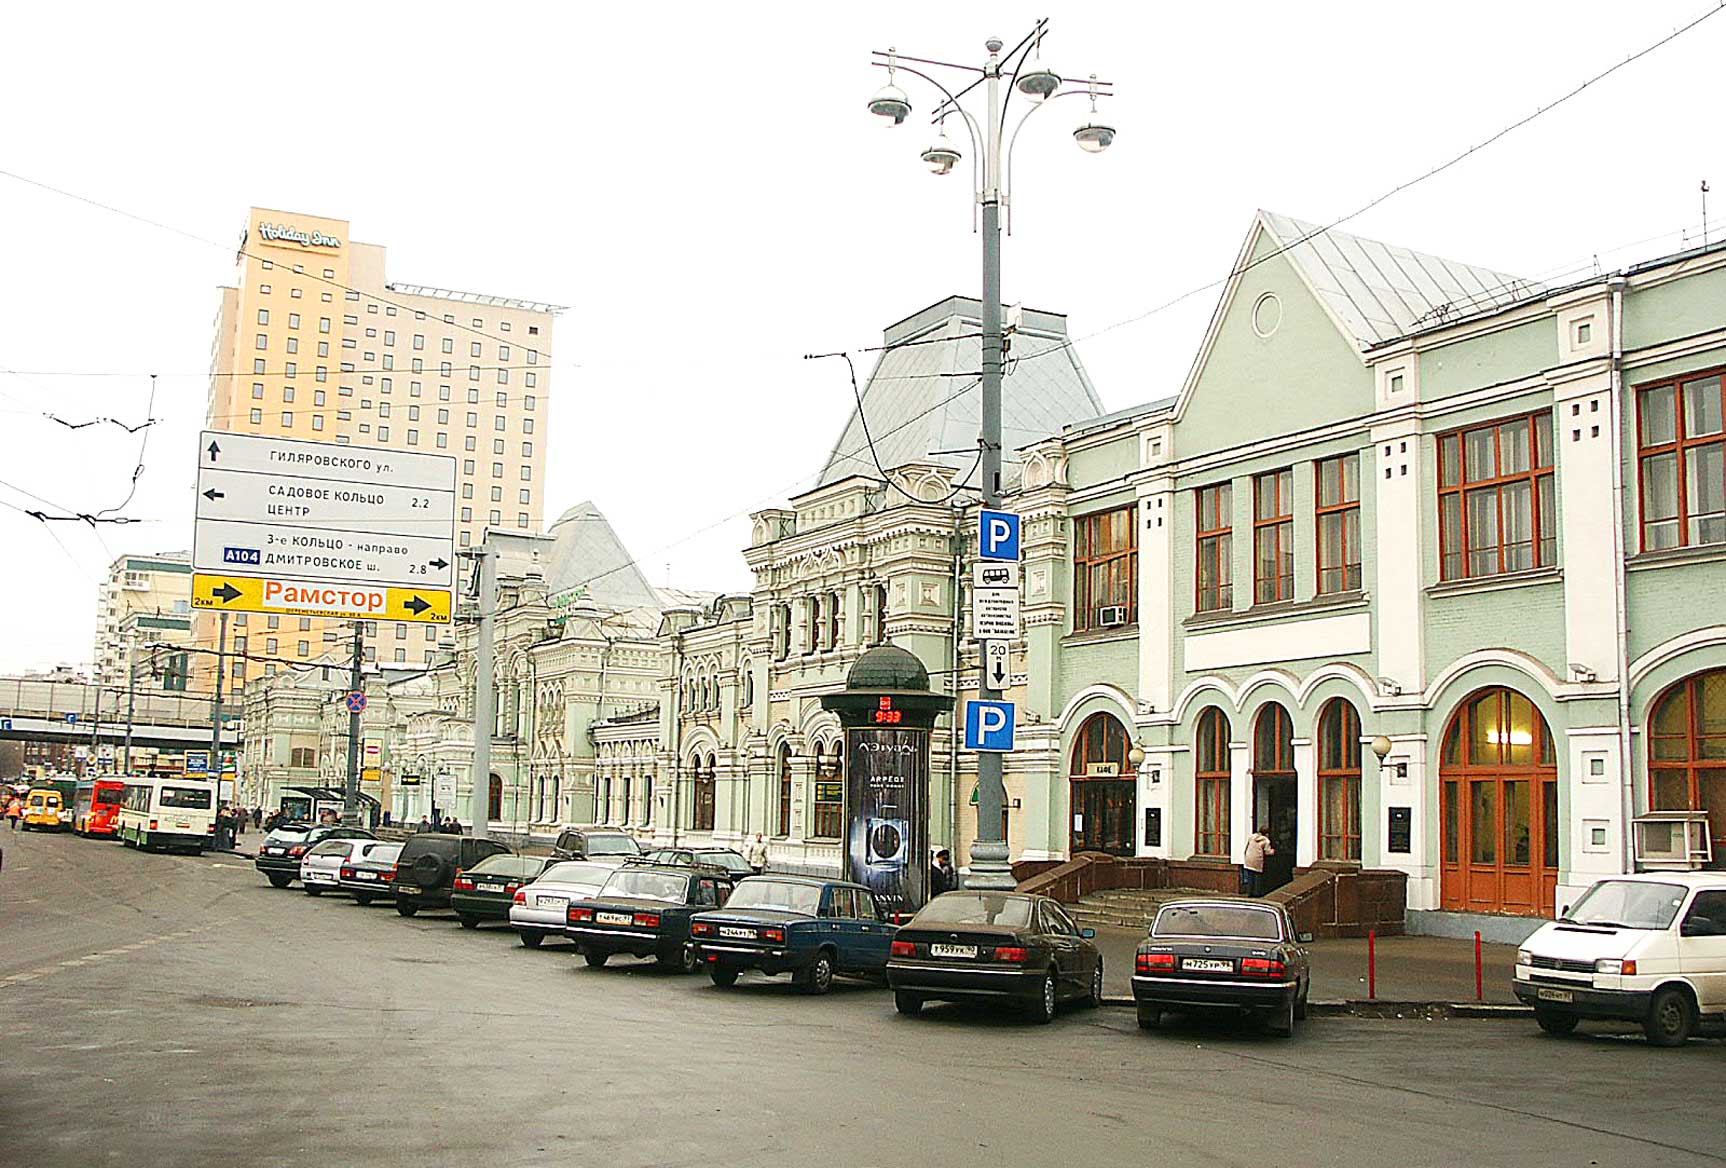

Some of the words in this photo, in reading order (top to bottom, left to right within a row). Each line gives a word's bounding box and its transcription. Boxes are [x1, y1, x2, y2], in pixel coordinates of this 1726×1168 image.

[260, 222, 310, 247] Holiday
[312, 230, 341, 248] Inn
[270, 451, 370, 470] ГИЛЯРОВСКОГО
[376, 463, 394, 473] ул.
[268, 485, 330, 500] САДОВОЕ
[334, 491, 384, 505] КОЛЬЦО
[412, 498, 430, 509] 2.2
[268, 504, 310, 517] ЦЕНТР
[267, 534, 287, 546] 3-е
[292, 536, 343, 550] КОЛЬЦО
[357, 543, 408, 556] направо
[265, 553, 362, 570] ДМИТРОВСКОЕ
[409, 564, 427, 575] 2.8
[266, 581, 384, 612] Рамстор
[990, 646, 1006, 656] 20
